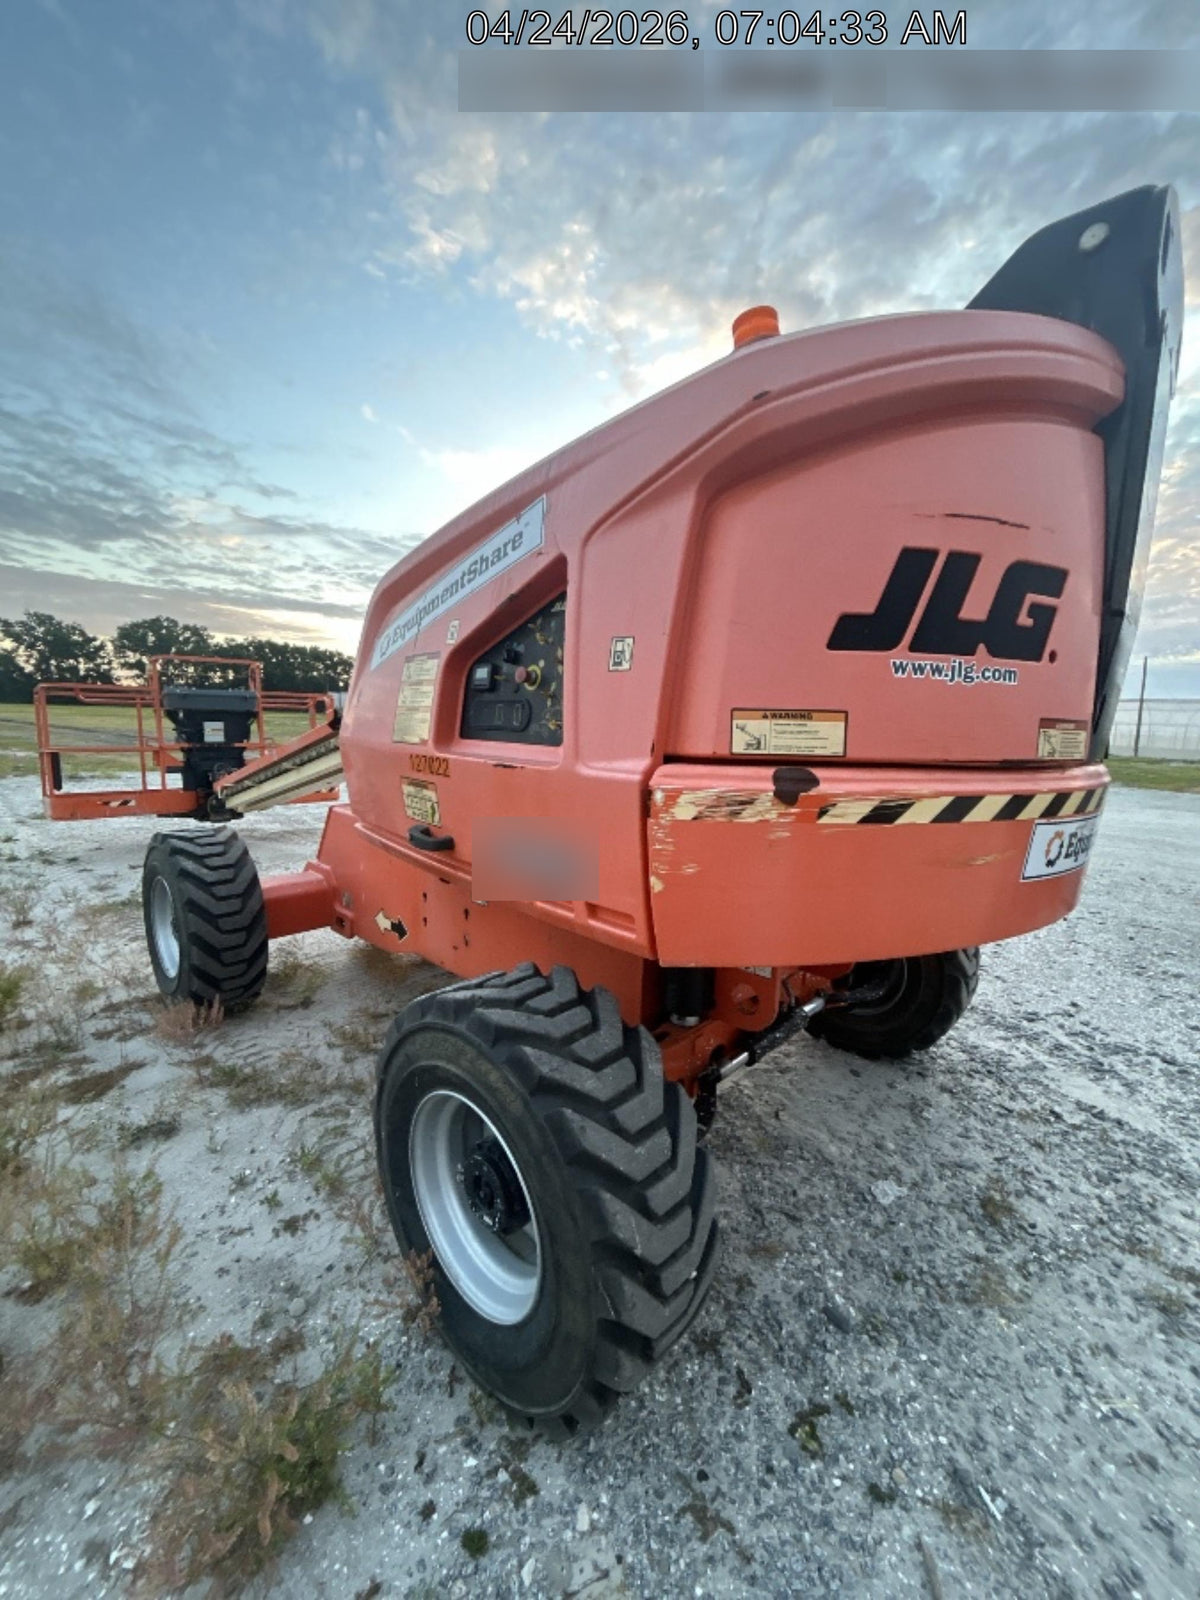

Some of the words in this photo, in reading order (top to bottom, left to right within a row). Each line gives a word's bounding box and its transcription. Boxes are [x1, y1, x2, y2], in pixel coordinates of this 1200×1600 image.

[391, 530, 523, 642] EquipmentShare
[826, 546, 1069, 662] JLG
[890, 658, 1018, 685] www.jlg.com
[770, 711, 814, 721] WARNING
